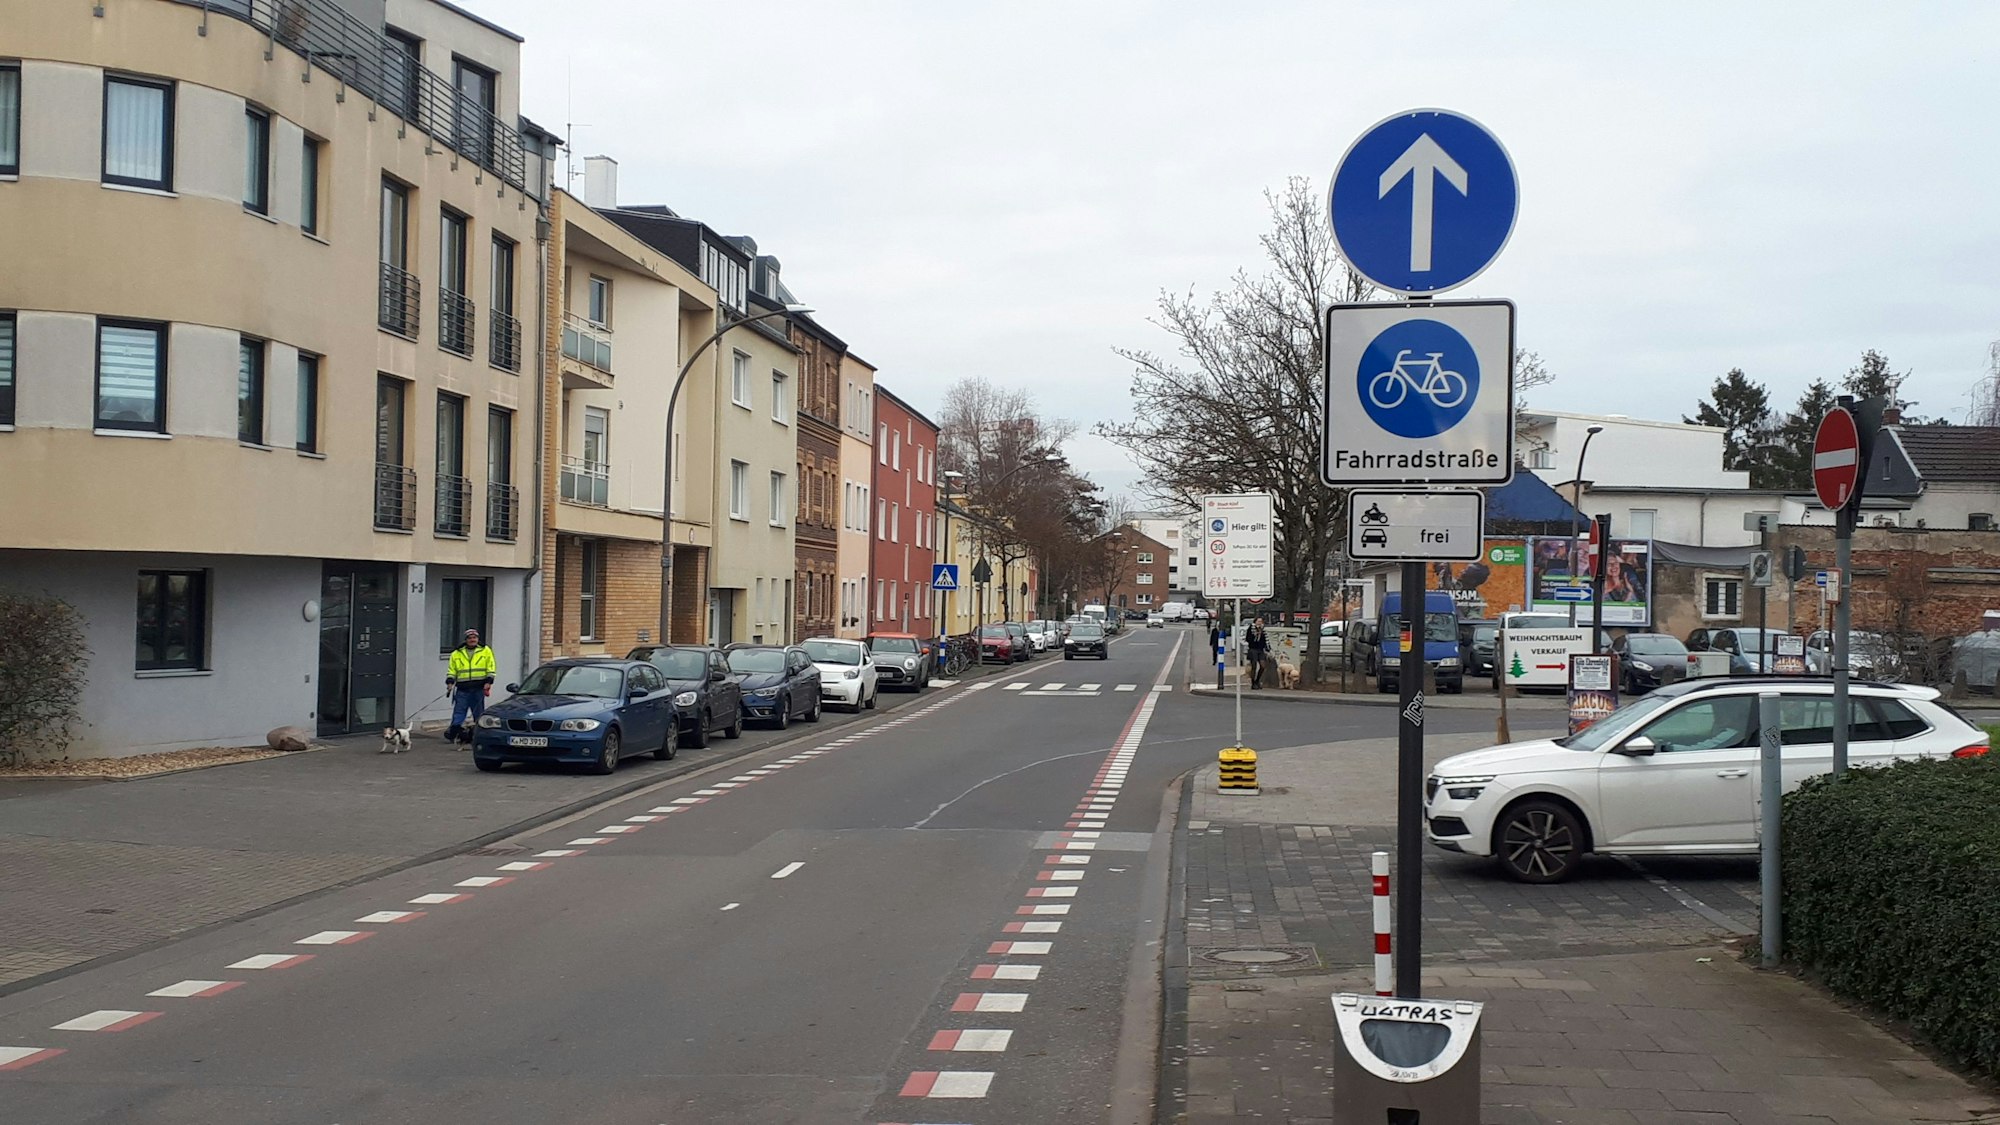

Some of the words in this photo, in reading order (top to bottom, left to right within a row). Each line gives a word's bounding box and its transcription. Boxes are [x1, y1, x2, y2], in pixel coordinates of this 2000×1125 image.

[1336, 449, 1498, 468] Fahrradstraße
[1231, 523, 1249, 531] Hier
[1250, 522, 1267, 532] gilt:
[1420, 529, 1449, 543] frei
[411, 582, 423, 594] 1-3
